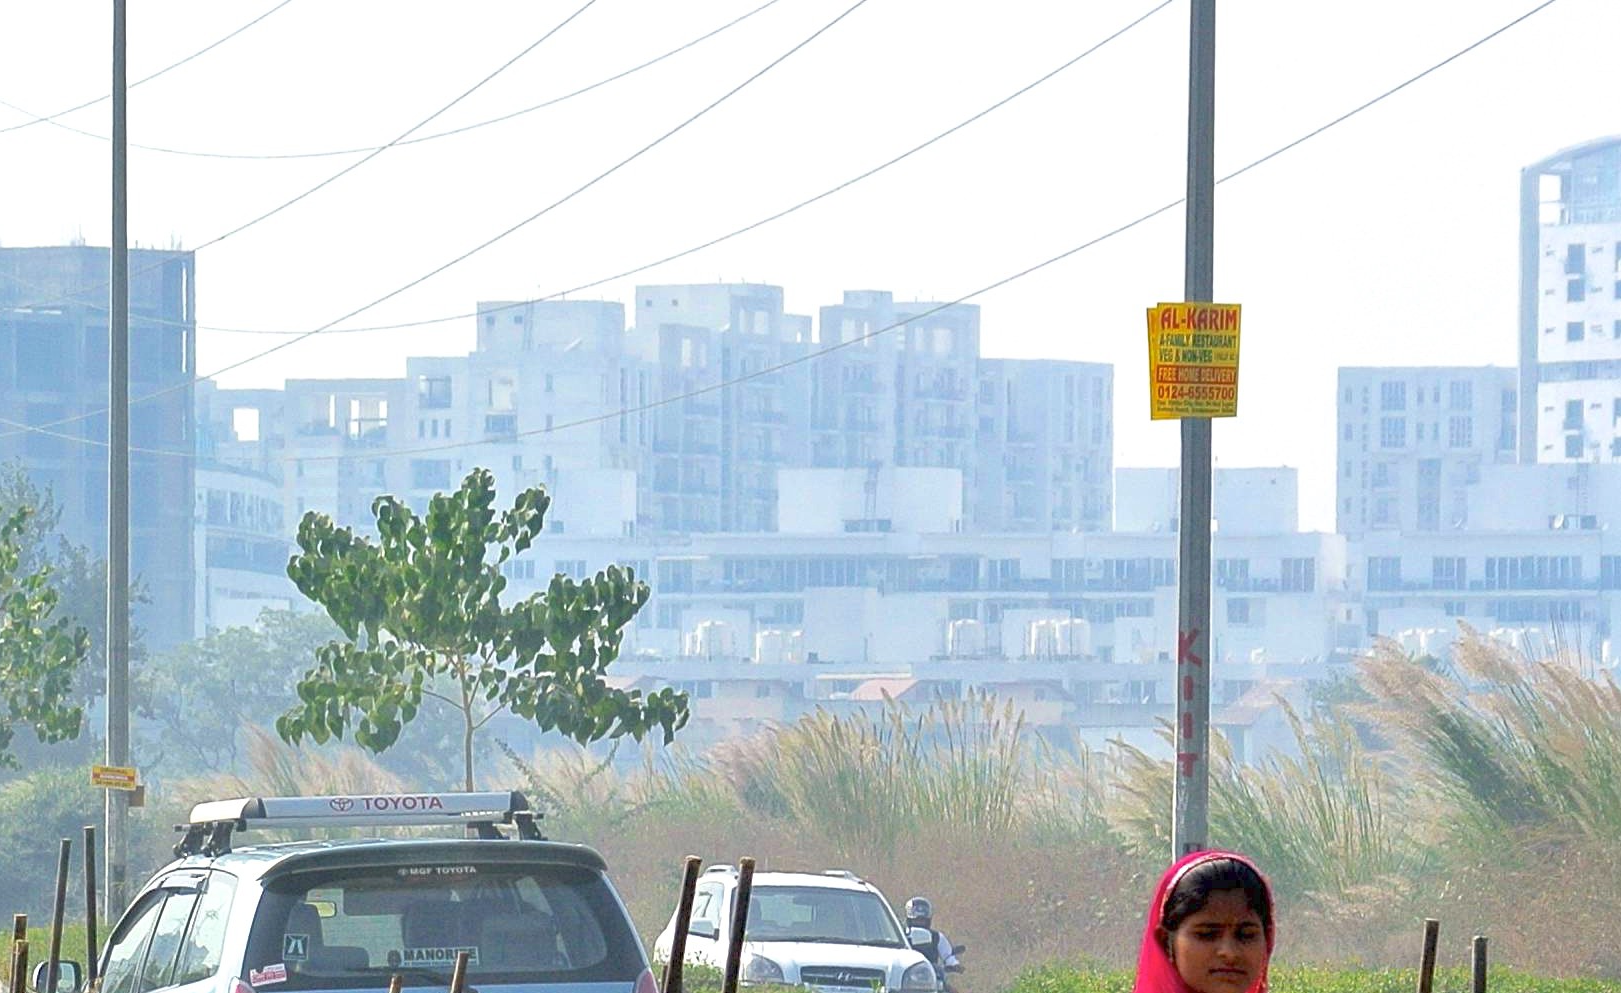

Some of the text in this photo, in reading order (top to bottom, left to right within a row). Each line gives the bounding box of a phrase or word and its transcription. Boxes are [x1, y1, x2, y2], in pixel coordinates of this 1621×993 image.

[1161, 306, 1237, 331] AL-KARIM
[1193, 334, 1236, 348] RESTAURANT
[1159, 348, 1174, 362] VEG
[1182, 349, 1213, 362] NON-VEG
[1159, 366, 1235, 383] FREE HOME DELIVERY
[1158, 385, 1235, 400] 0124-6555700
[362, 796, 443, 811] TOYOTA
[410, 866, 476, 876] MGF TOYOTA
